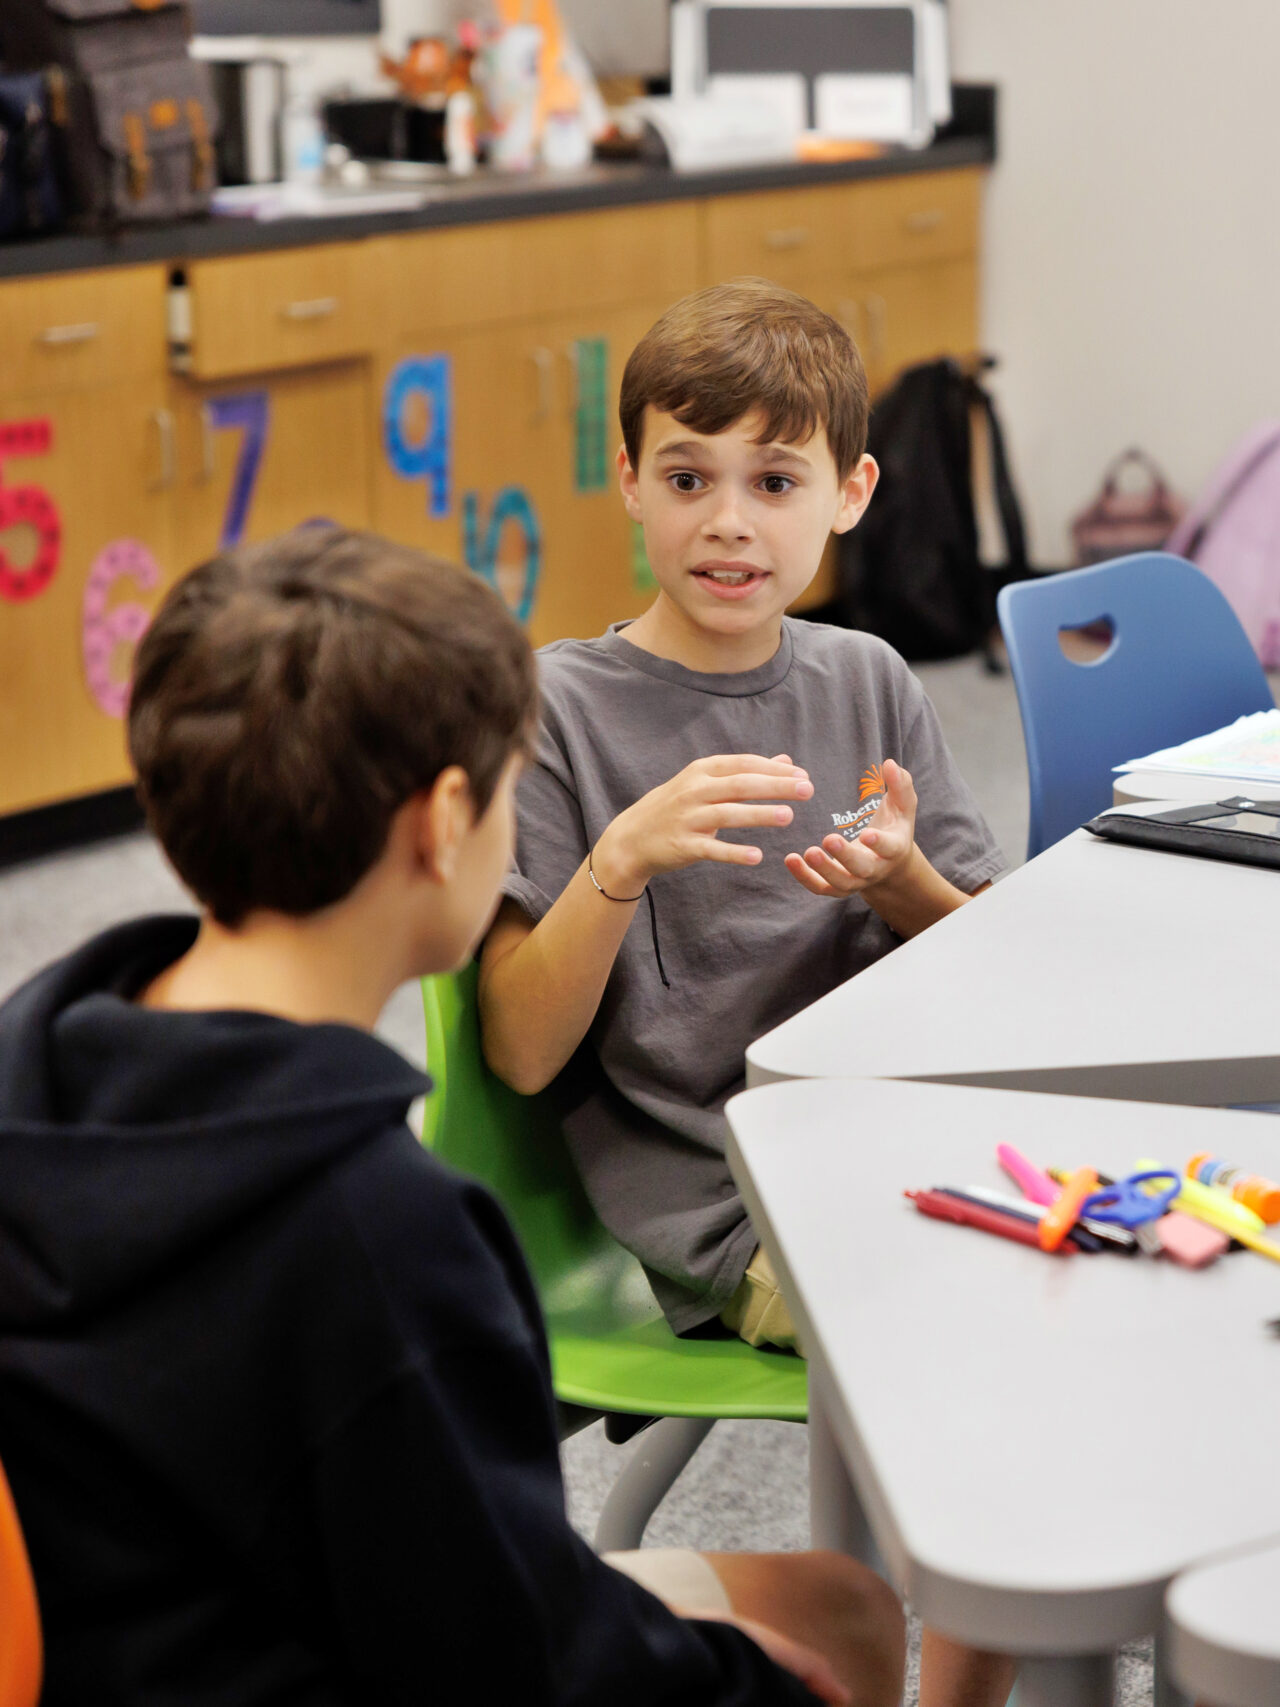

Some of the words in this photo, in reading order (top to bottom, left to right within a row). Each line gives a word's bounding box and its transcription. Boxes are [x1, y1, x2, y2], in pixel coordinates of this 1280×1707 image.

[0, 418, 61, 603] 5
[204, 391, 270, 556] 7
[80, 533, 161, 718] 6
